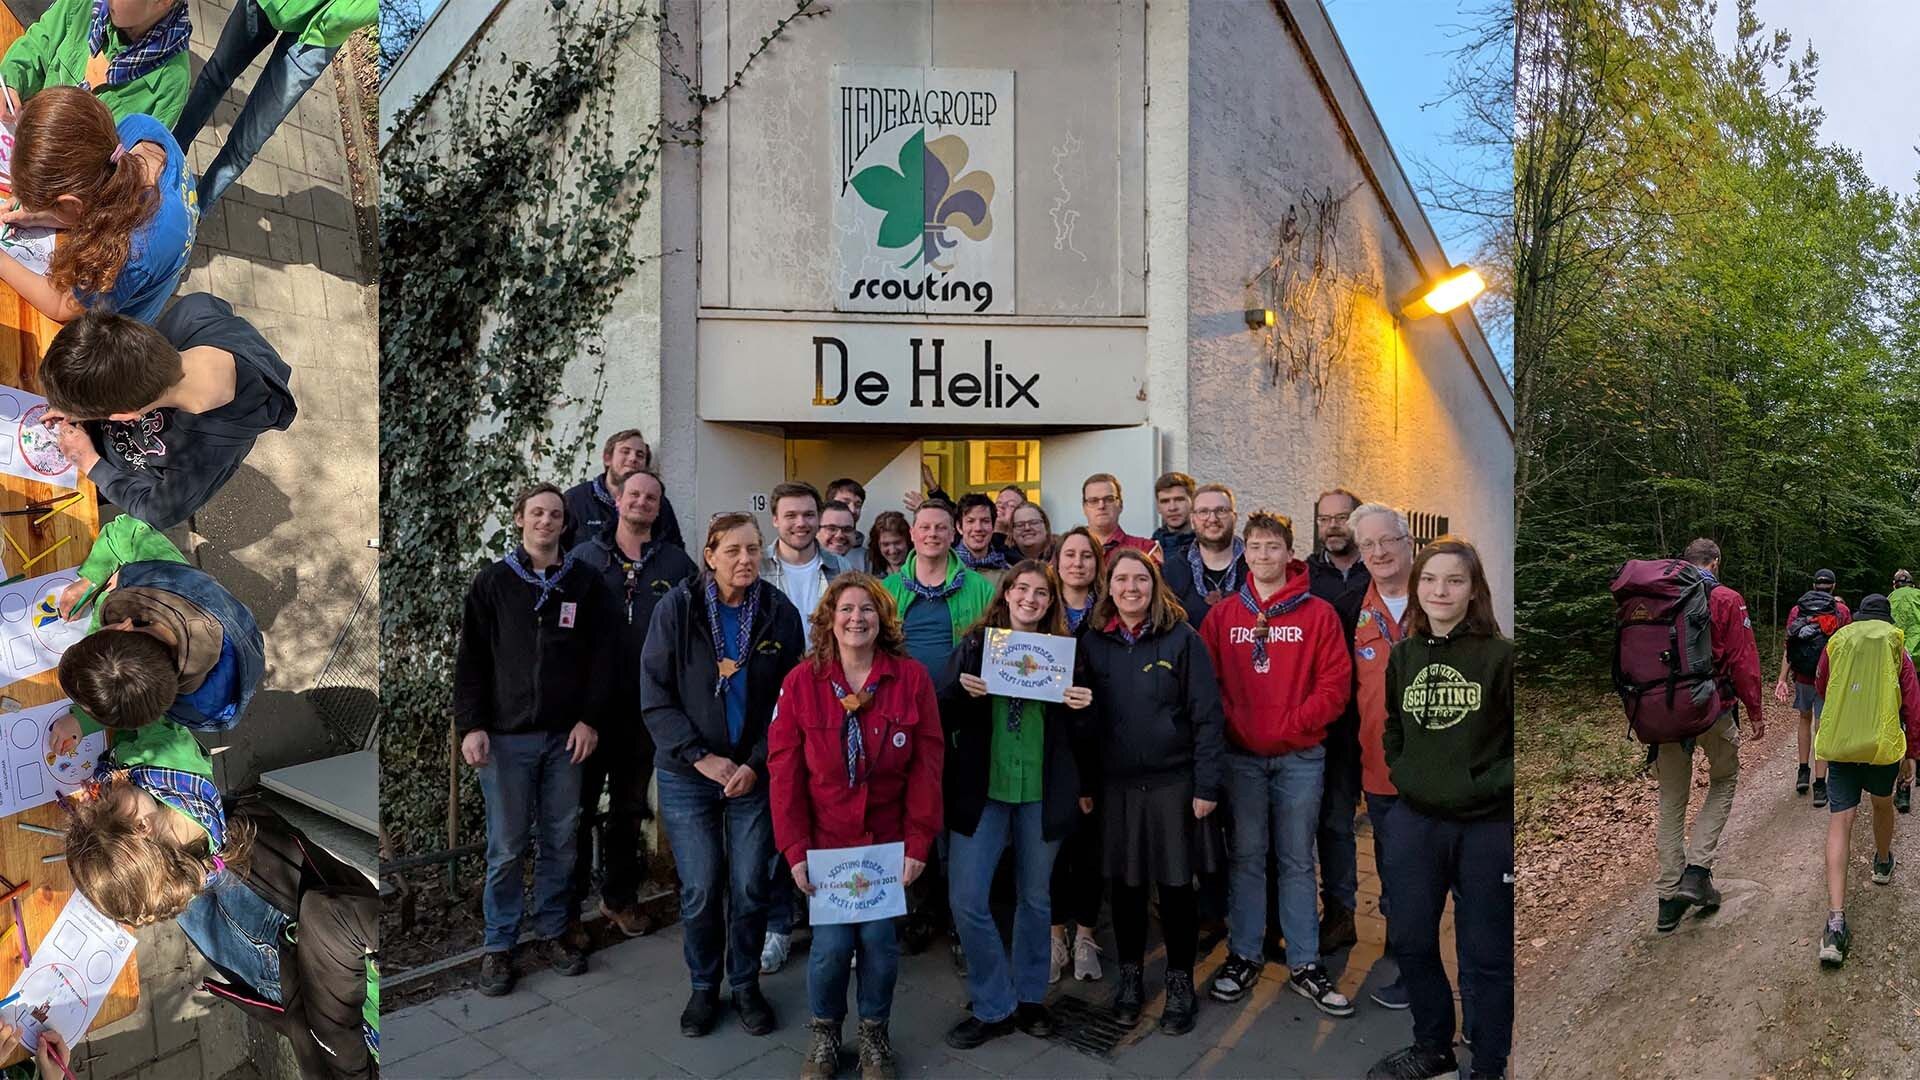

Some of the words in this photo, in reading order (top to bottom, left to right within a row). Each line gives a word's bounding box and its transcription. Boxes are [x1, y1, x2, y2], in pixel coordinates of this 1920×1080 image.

[840, 86, 997, 197] HEDERAGROEP
[849, 271, 993, 312] scouting
[812, 336, 890, 407] De
[909, 338, 1040, 408] Helix
[752, 495, 766, 511] 19
[1230, 626, 1304, 644] FIREARTER
[1407, 687, 1477, 707] SCOUTING
